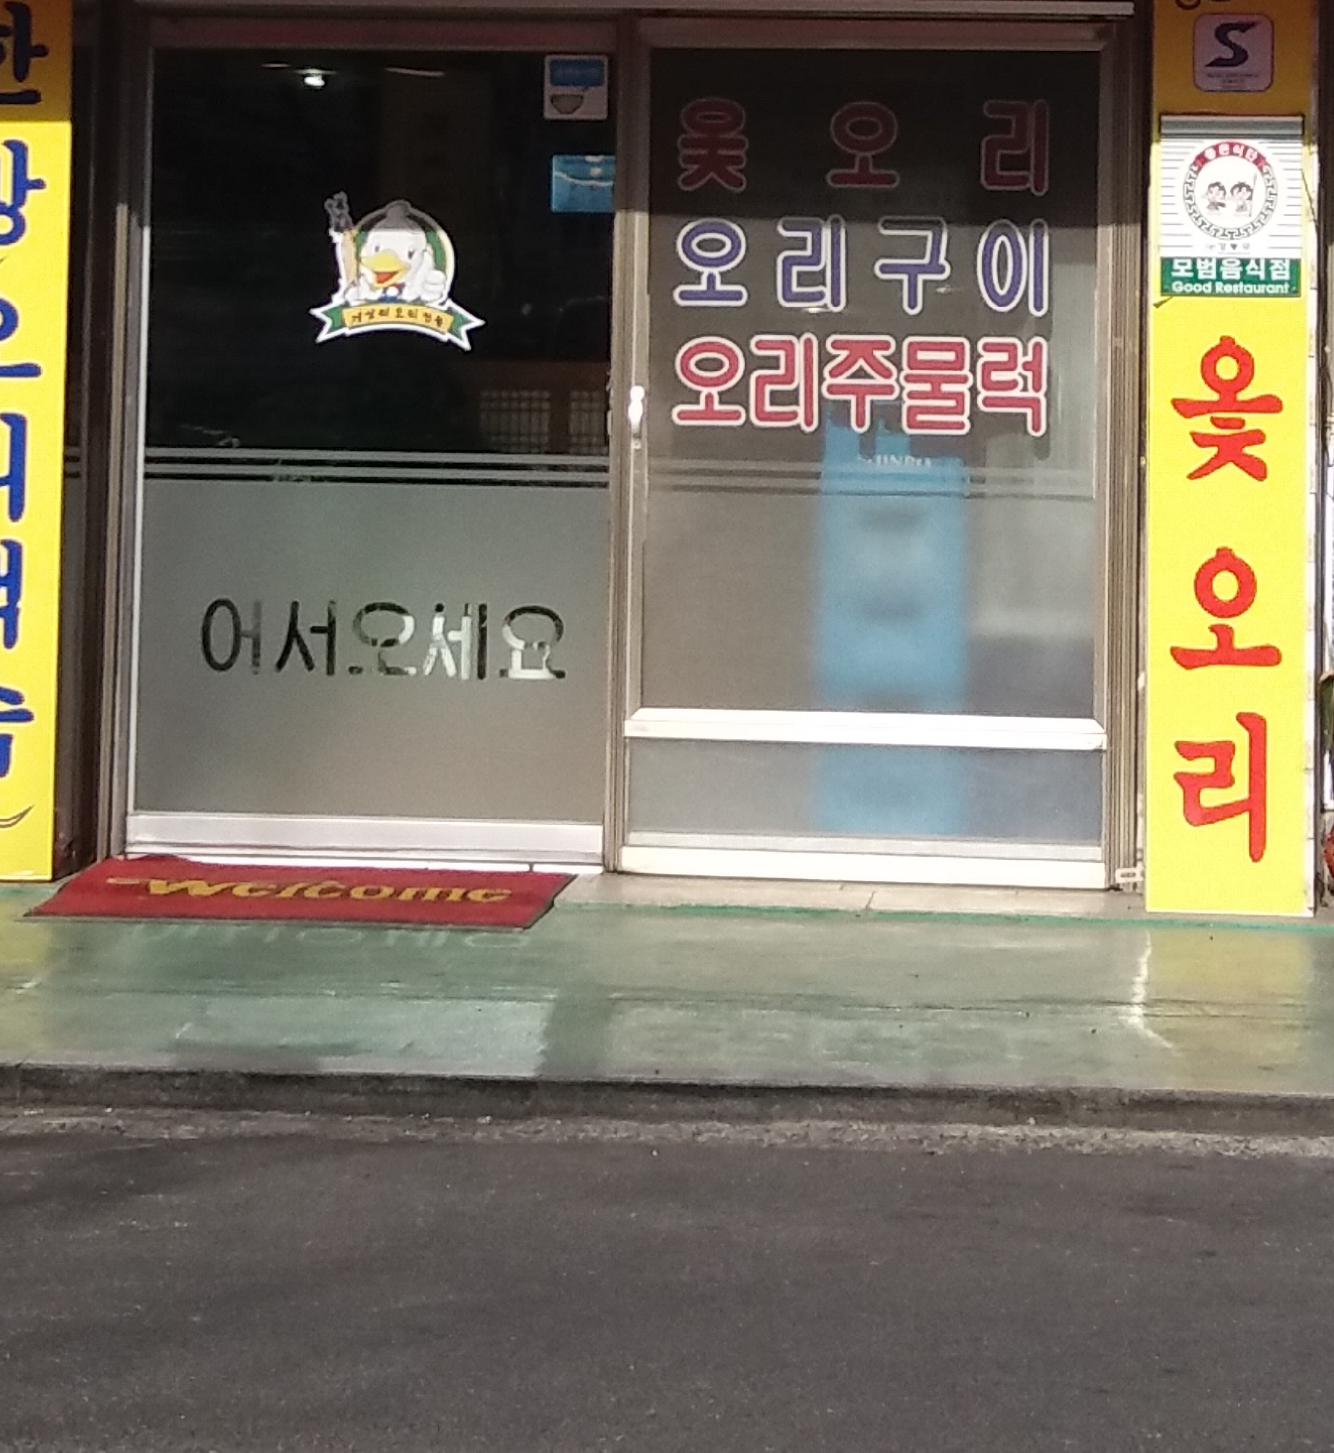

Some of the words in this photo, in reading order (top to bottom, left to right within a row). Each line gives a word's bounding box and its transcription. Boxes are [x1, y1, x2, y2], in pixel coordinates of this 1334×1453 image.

[1172, 258, 1292, 280] 모범음식점
[1171, 280, 1213, 295] Good
[1215, 281, 1291, 296] Restaurant
[671, 333, 1051, 437] 오리주물럭
[201, 597, 566, 680] 어서오세요
[106, 876, 512, 904] Welcome
